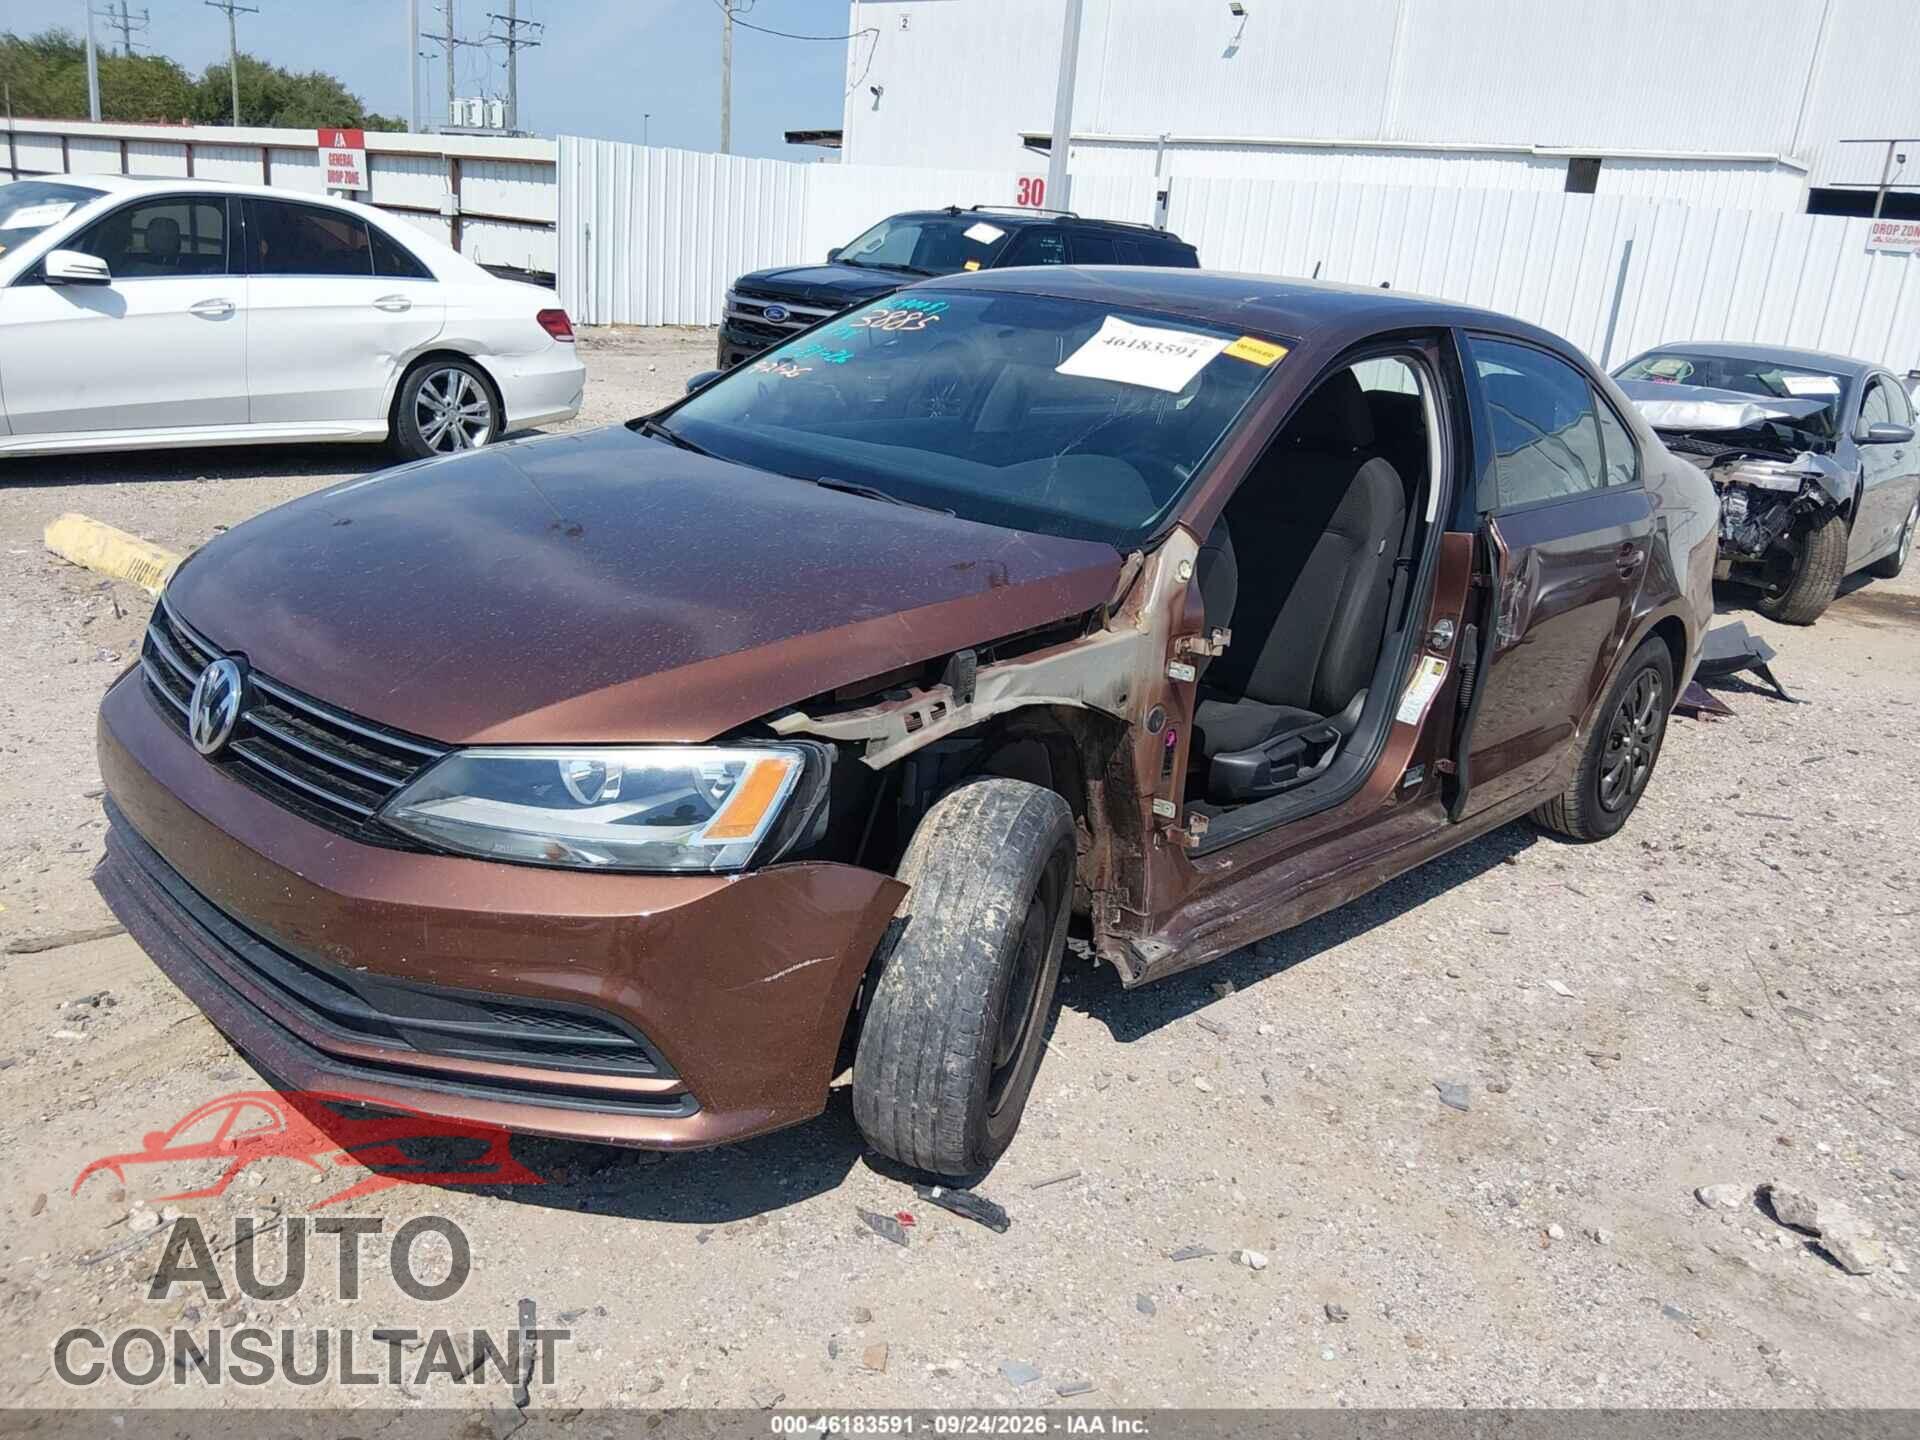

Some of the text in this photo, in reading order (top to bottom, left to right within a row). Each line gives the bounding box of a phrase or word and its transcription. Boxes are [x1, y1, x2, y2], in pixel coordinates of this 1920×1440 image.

[902, 17, 908, 29] 2
[1017, 177, 1045, 207] 30
[1872, 223, 1899, 236] DROP
[1102, 335, 1199, 359] 46183591
